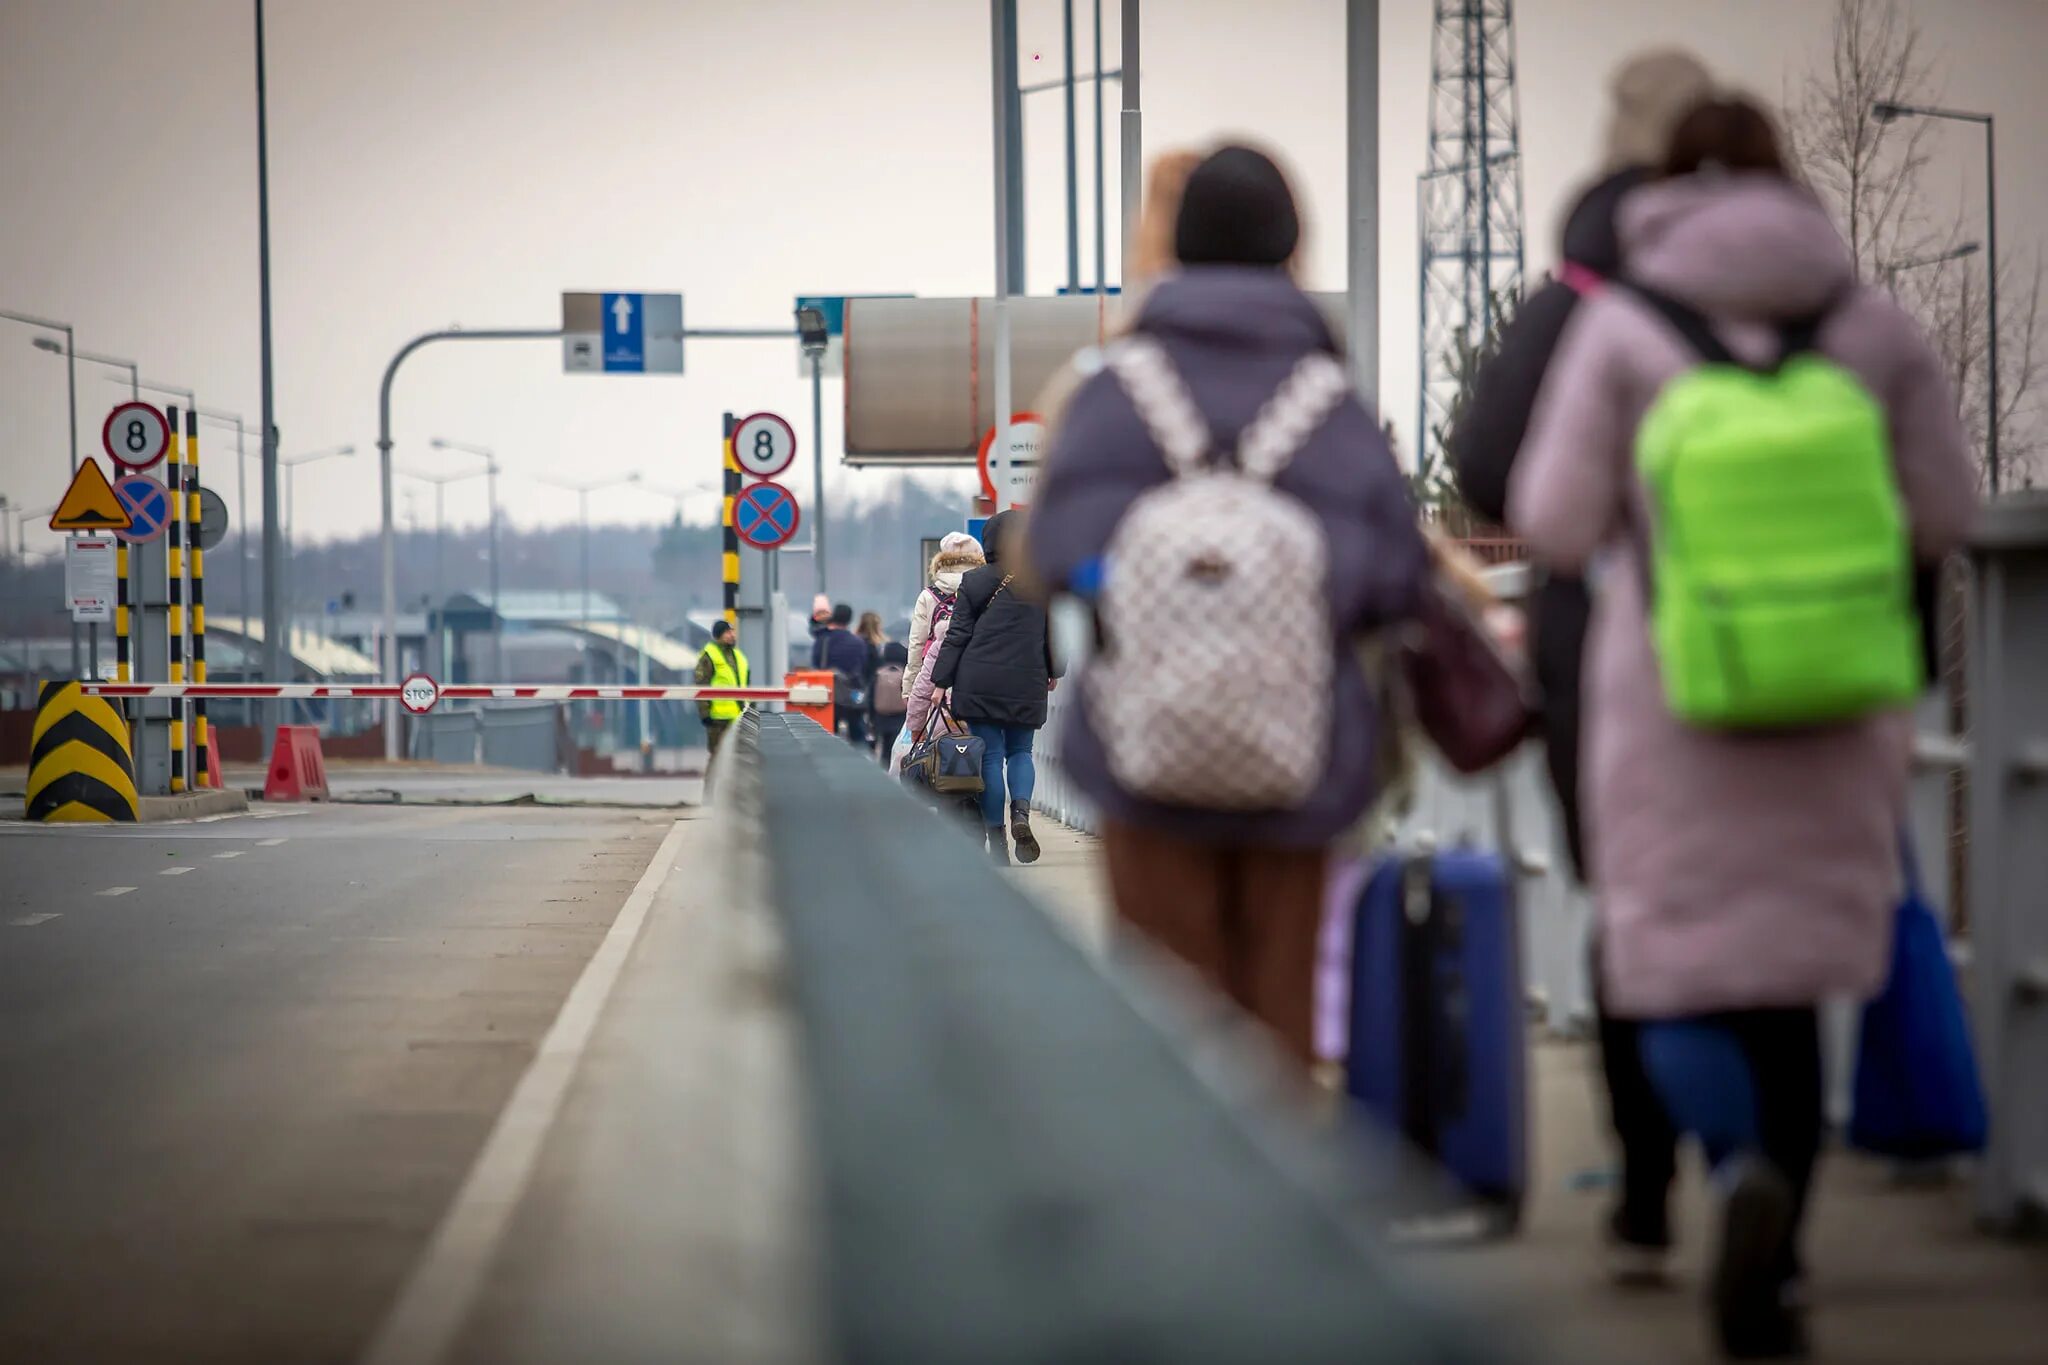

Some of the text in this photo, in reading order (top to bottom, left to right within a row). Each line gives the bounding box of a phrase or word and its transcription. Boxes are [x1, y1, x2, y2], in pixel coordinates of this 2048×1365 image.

[127, 420, 146, 453] 8
[754, 430, 773, 461] 8
[405, 689, 434, 700] STOP
